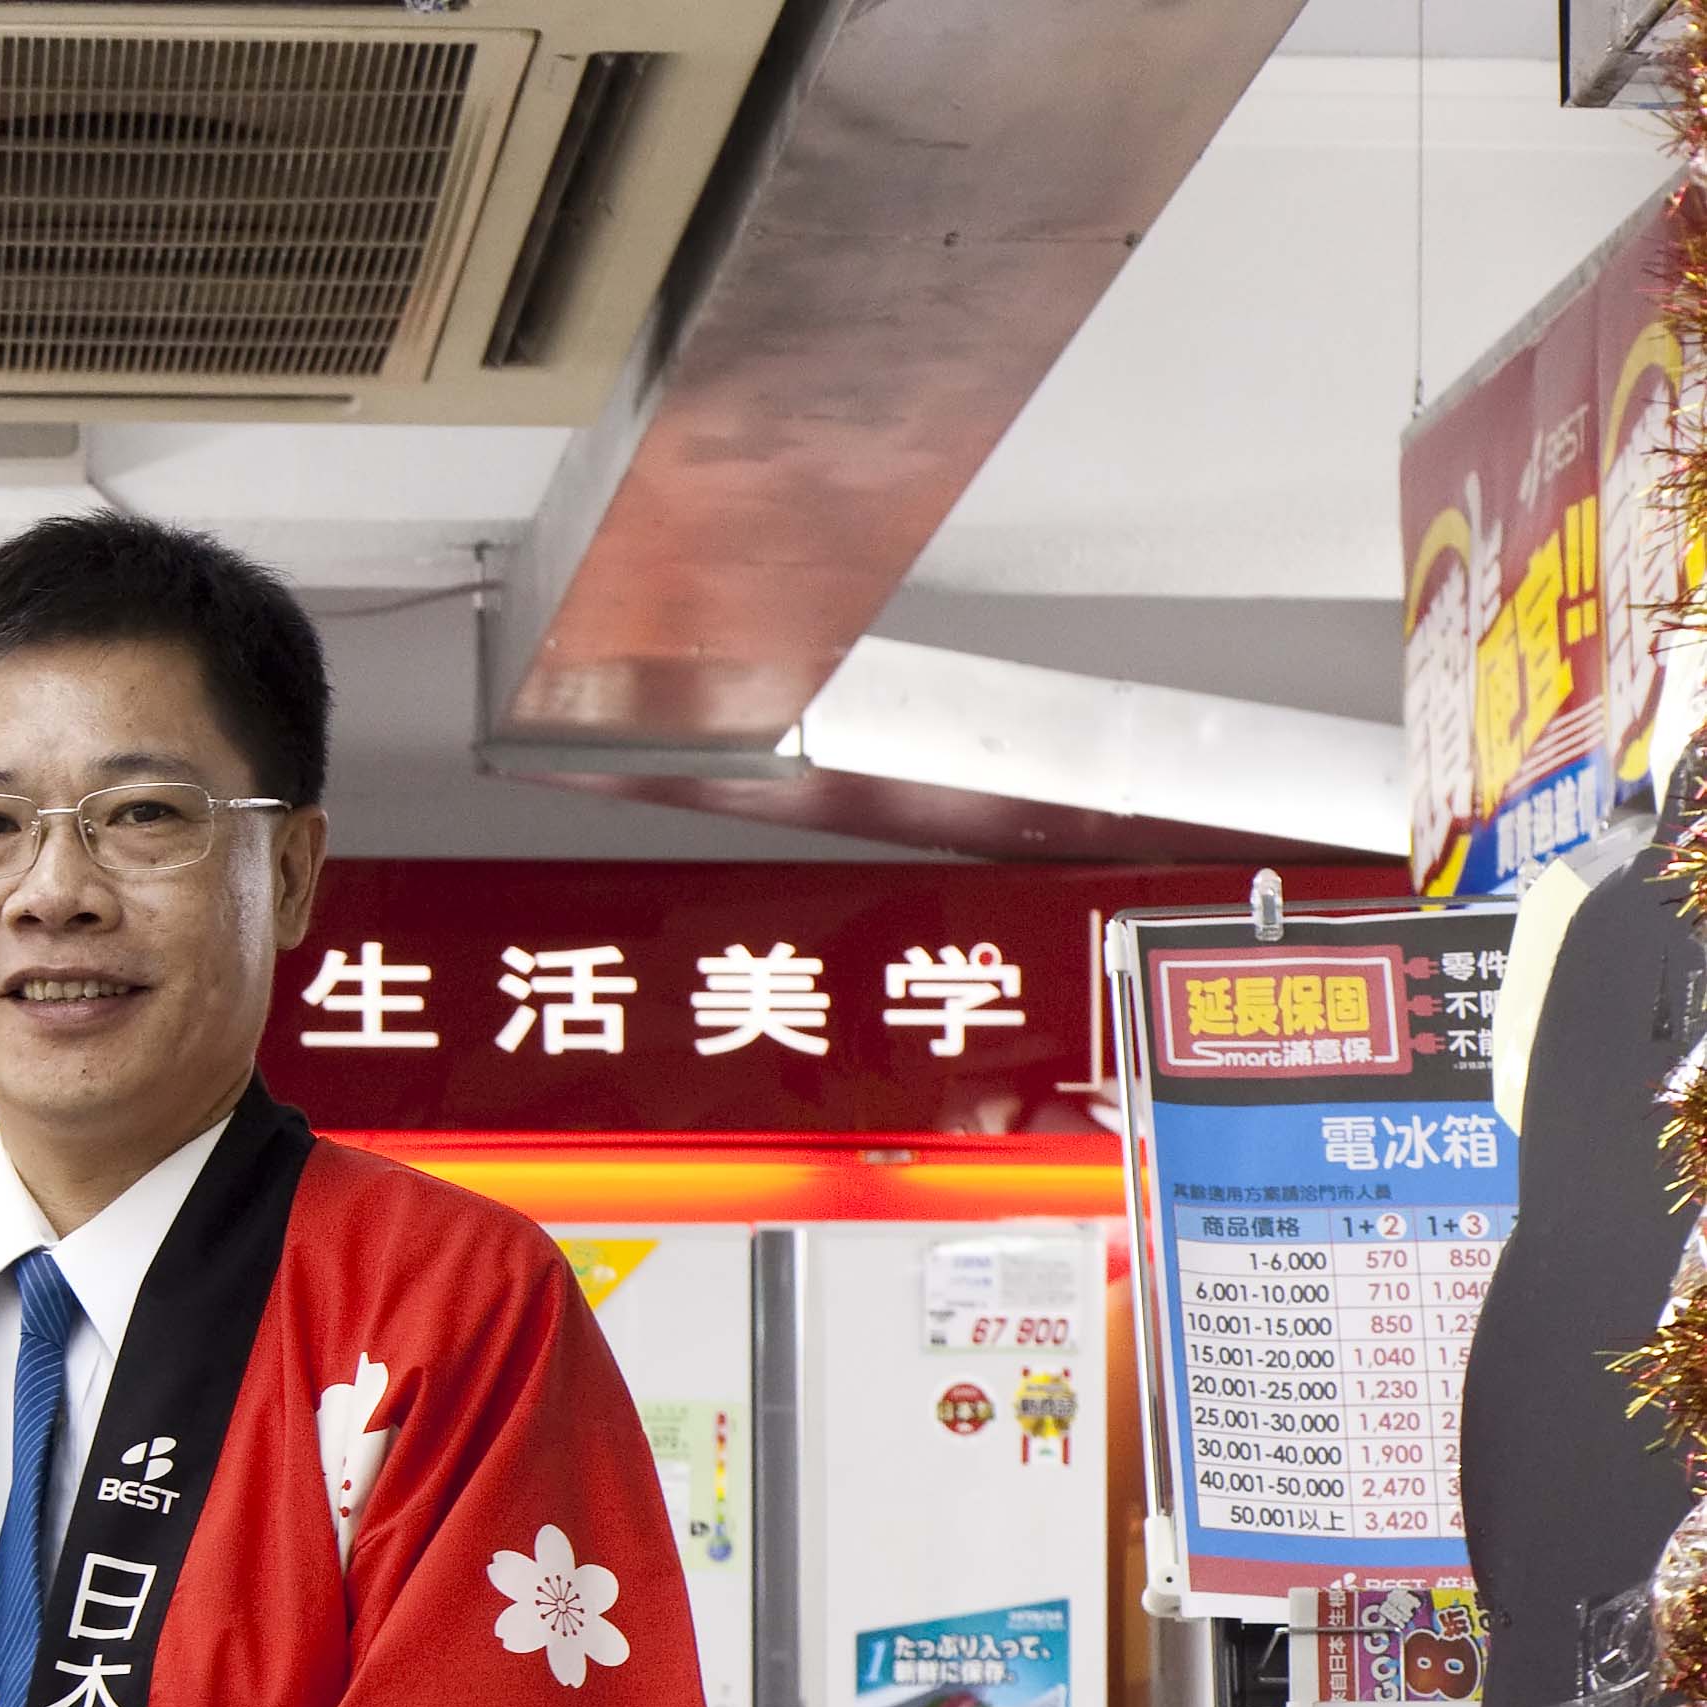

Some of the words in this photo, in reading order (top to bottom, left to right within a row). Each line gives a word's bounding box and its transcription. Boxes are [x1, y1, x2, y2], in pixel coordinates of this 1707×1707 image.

[301, 942, 1025, 1056] 生活美学
[1186, 976, 1370, 1036] 延長保固
[1322, 1114, 1498, 1170] 電冰箱
[1202, 1216, 1300, 1237] 商品價格
[1250, 1252, 1327, 1272] 1-6,000
[1366, 1250, 1406, 1268] 570
[1449, 1249, 1490, 1267] 850
[1196, 1283, 1329, 1305] 6,001-10,000
[1369, 1283, 1410, 1300] 710
[1189, 1313, 1332, 1338] 10,001-15,000
[1371, 1315, 1412, 1333] 850
[1437, 1314, 1477, 1334] 1,23
[1191, 1345, 1334, 1370] 15,001-20,000
[1355, 1348, 1414, 1369] 1,040
[1193, 1376, 1336, 1402] 20,001-25,000
[1357, 1380, 1417, 1400] 1,230
[1195, 1407, 1339, 1434] 25,001-30,000
[1359, 1412, 1419, 1433] 1,420
[1198, 1439, 1342, 1466] 30,001-40,000
[1362, 1445, 1422, 1466] 1,900
[98, 1480, 180, 1514] BEST
[1201, 1471, 1343, 1498] 40,001-50,000
[1363, 1478, 1425, 1498] 2,470
[1231, 1506, 1345, 1532] 50,001以上
[1366, 1511, 1427, 1533] 3,420
